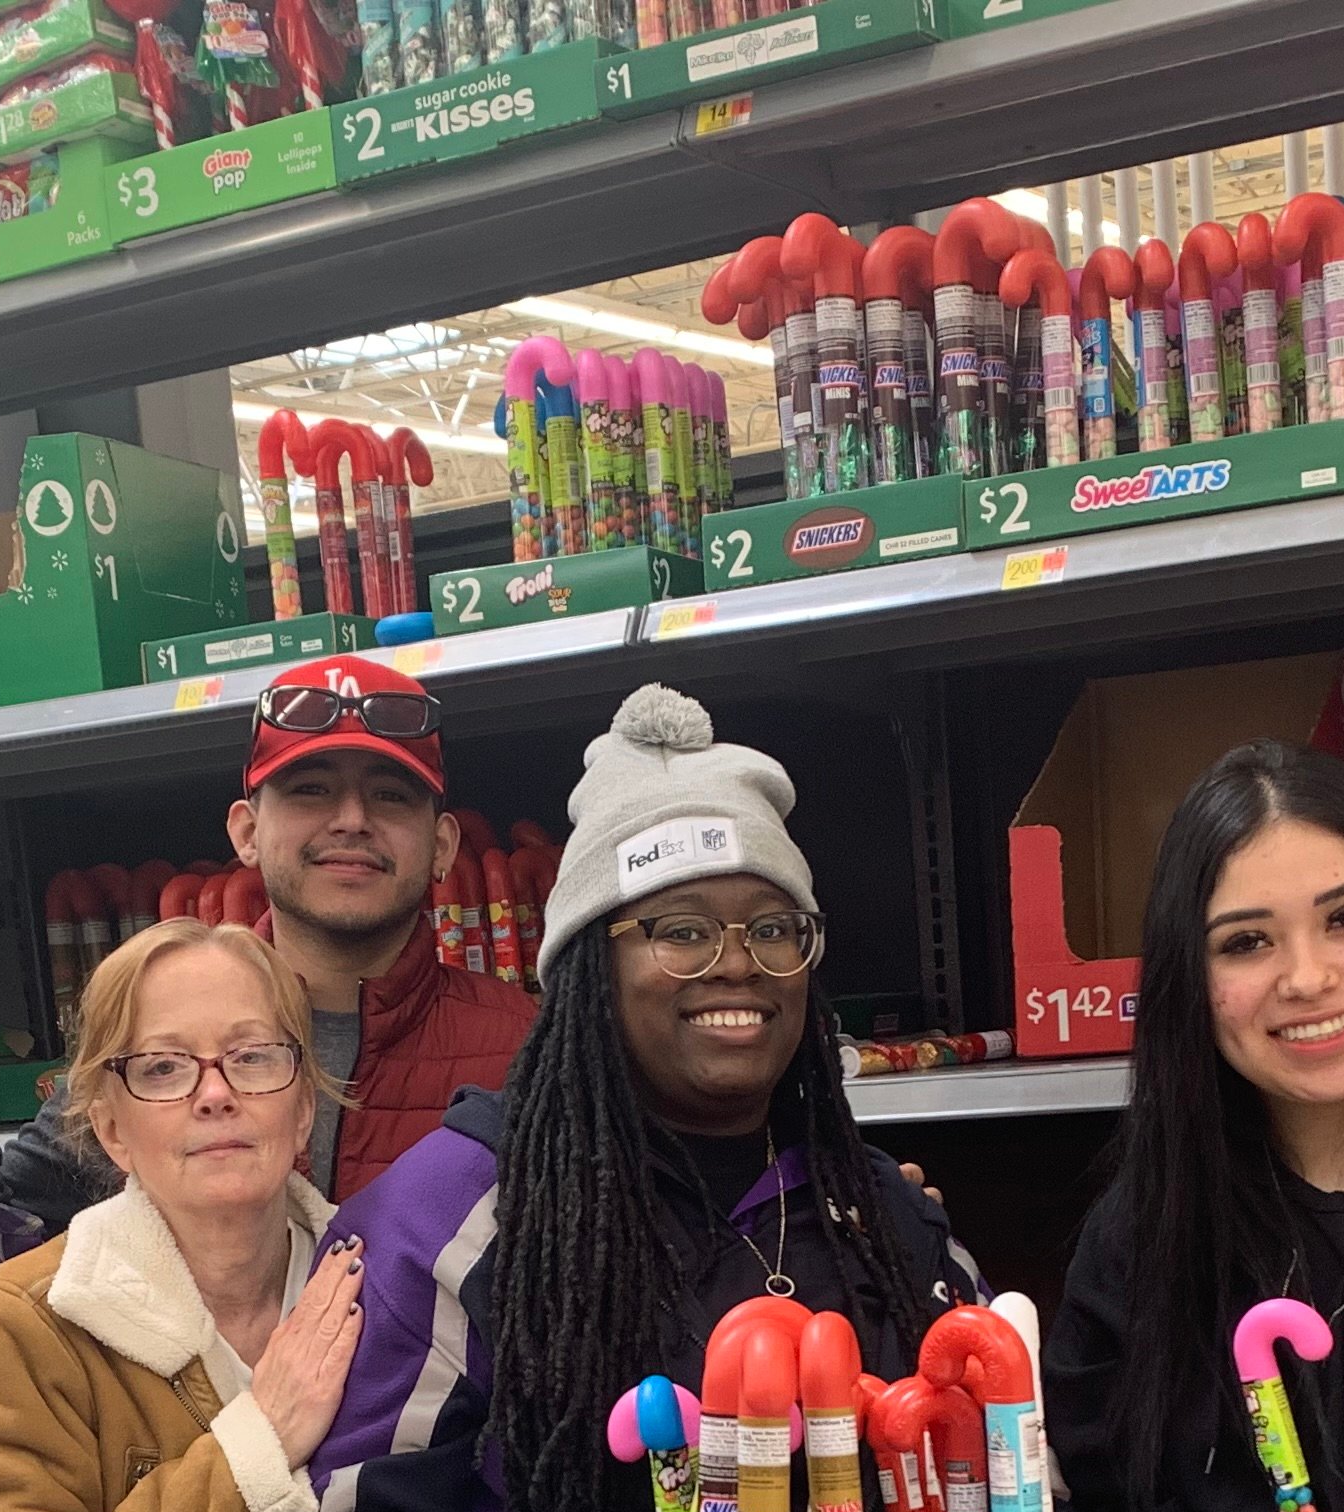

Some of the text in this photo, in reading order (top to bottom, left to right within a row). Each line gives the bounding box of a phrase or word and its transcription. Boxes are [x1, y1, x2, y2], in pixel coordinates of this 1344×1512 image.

[414, 70, 512, 112] sugar cookie
[607, 63, 632, 100] $1
[277, 142, 323, 163] Lollipops
[342, 107, 386, 161] $2
[203, 147, 252, 179] Giant
[213, 168, 246, 194] pop
[286, 158, 317, 175] Inside
[117, 166, 159, 217] $3
[66, 227, 102, 246] Packs
[1072, 460, 1230, 511] SweeTARTS
[979, 483, 1031, 534] $2
[791, 515, 866, 553] SNICKERS
[908, 537, 930, 546] FILLED
[710, 529, 755, 578] $2
[94, 553, 120, 602] $1
[505, 563, 554, 604] Trolli
[441, 579, 484, 623] $2
[157, 645, 178, 676] $1
[626, 837, 687, 873] FedEx
[703, 832, 727, 850] NFL
[1025, 985, 1113, 1043] $142
